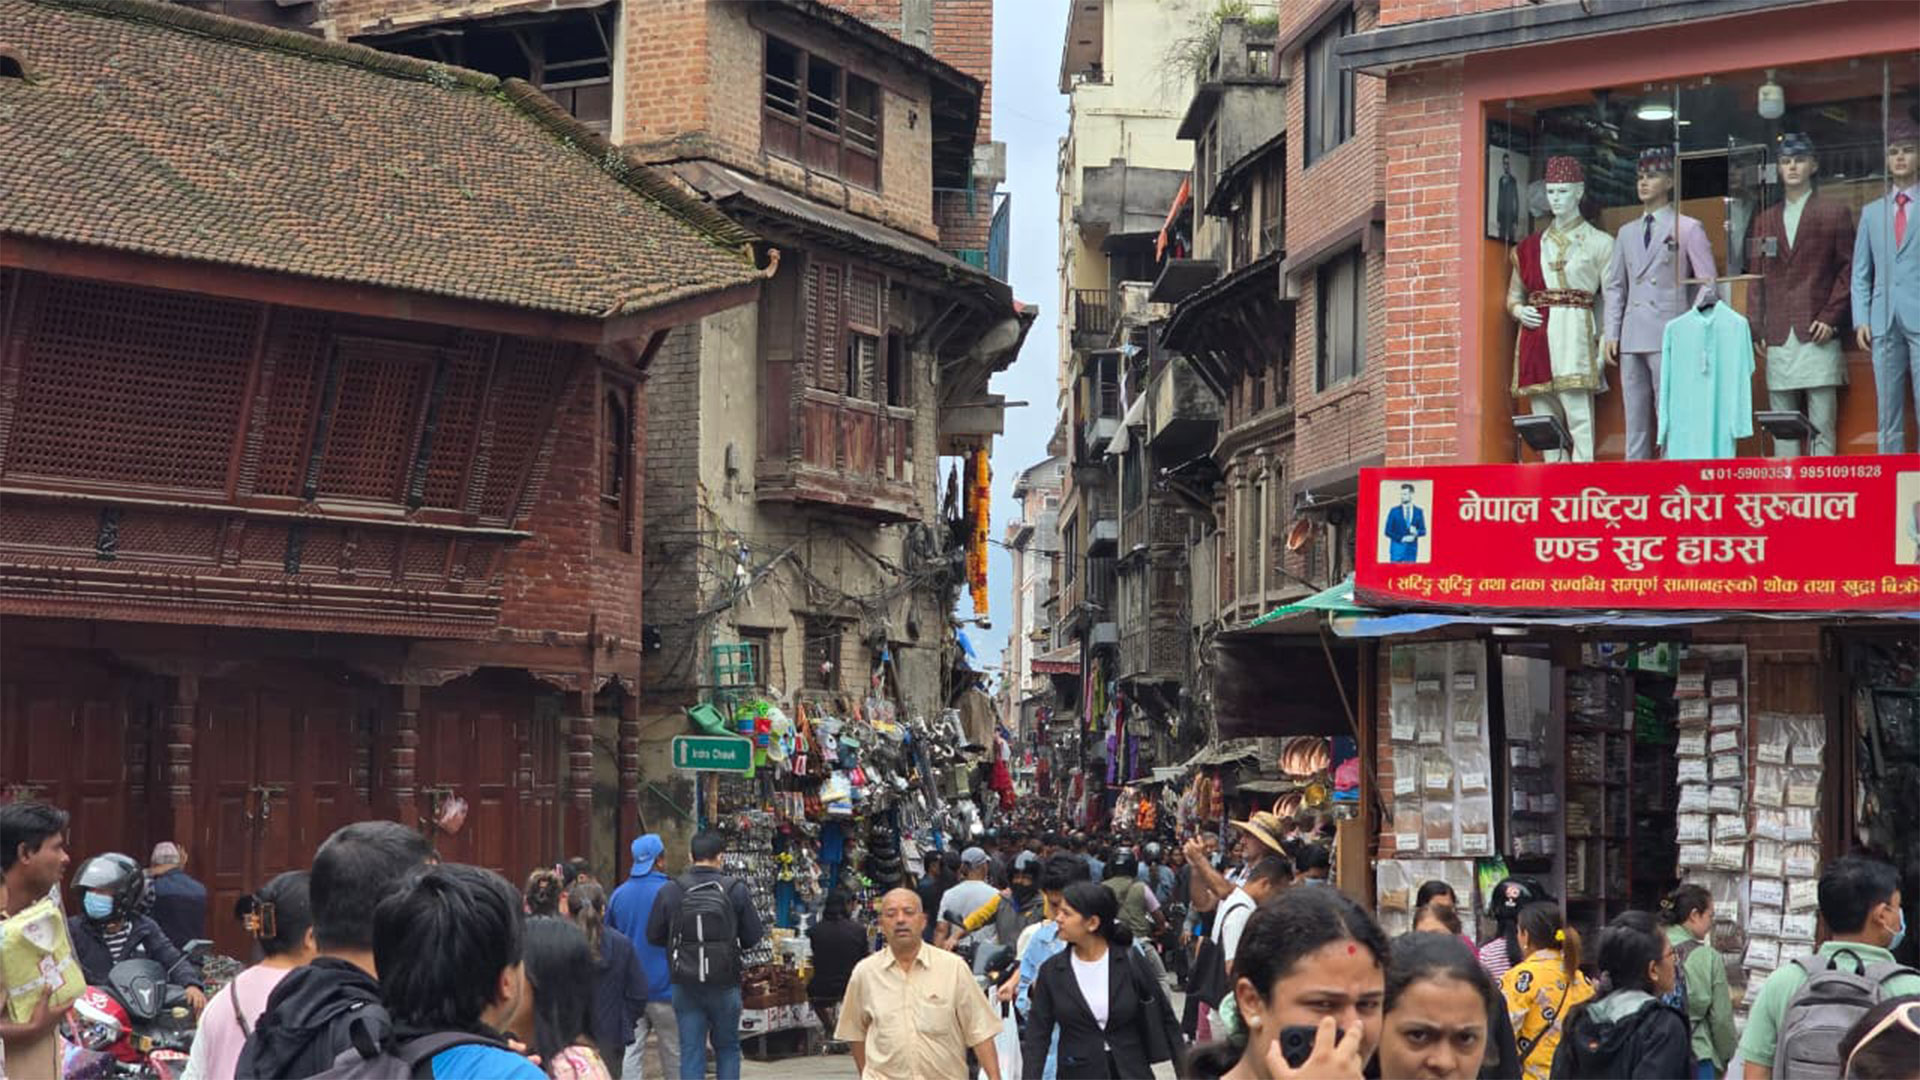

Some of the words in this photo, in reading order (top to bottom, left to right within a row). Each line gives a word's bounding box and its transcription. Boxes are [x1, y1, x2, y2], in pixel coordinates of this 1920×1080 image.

[1799, 465, 1882, 479] 9851091828
[1458, 489, 1541, 523] नेपाल
[1550, 487, 1650, 529] राष्ट्रिय
[1660, 484, 1724, 522] दौरा
[1533, 536, 1603, 563] एण्ड
[1612, 536, 1667, 571] सुट
[1676, 536, 1768, 565] हाउस
[1478, 577, 1506, 592] तथा
[1803, 579, 1836, 594] तथा
